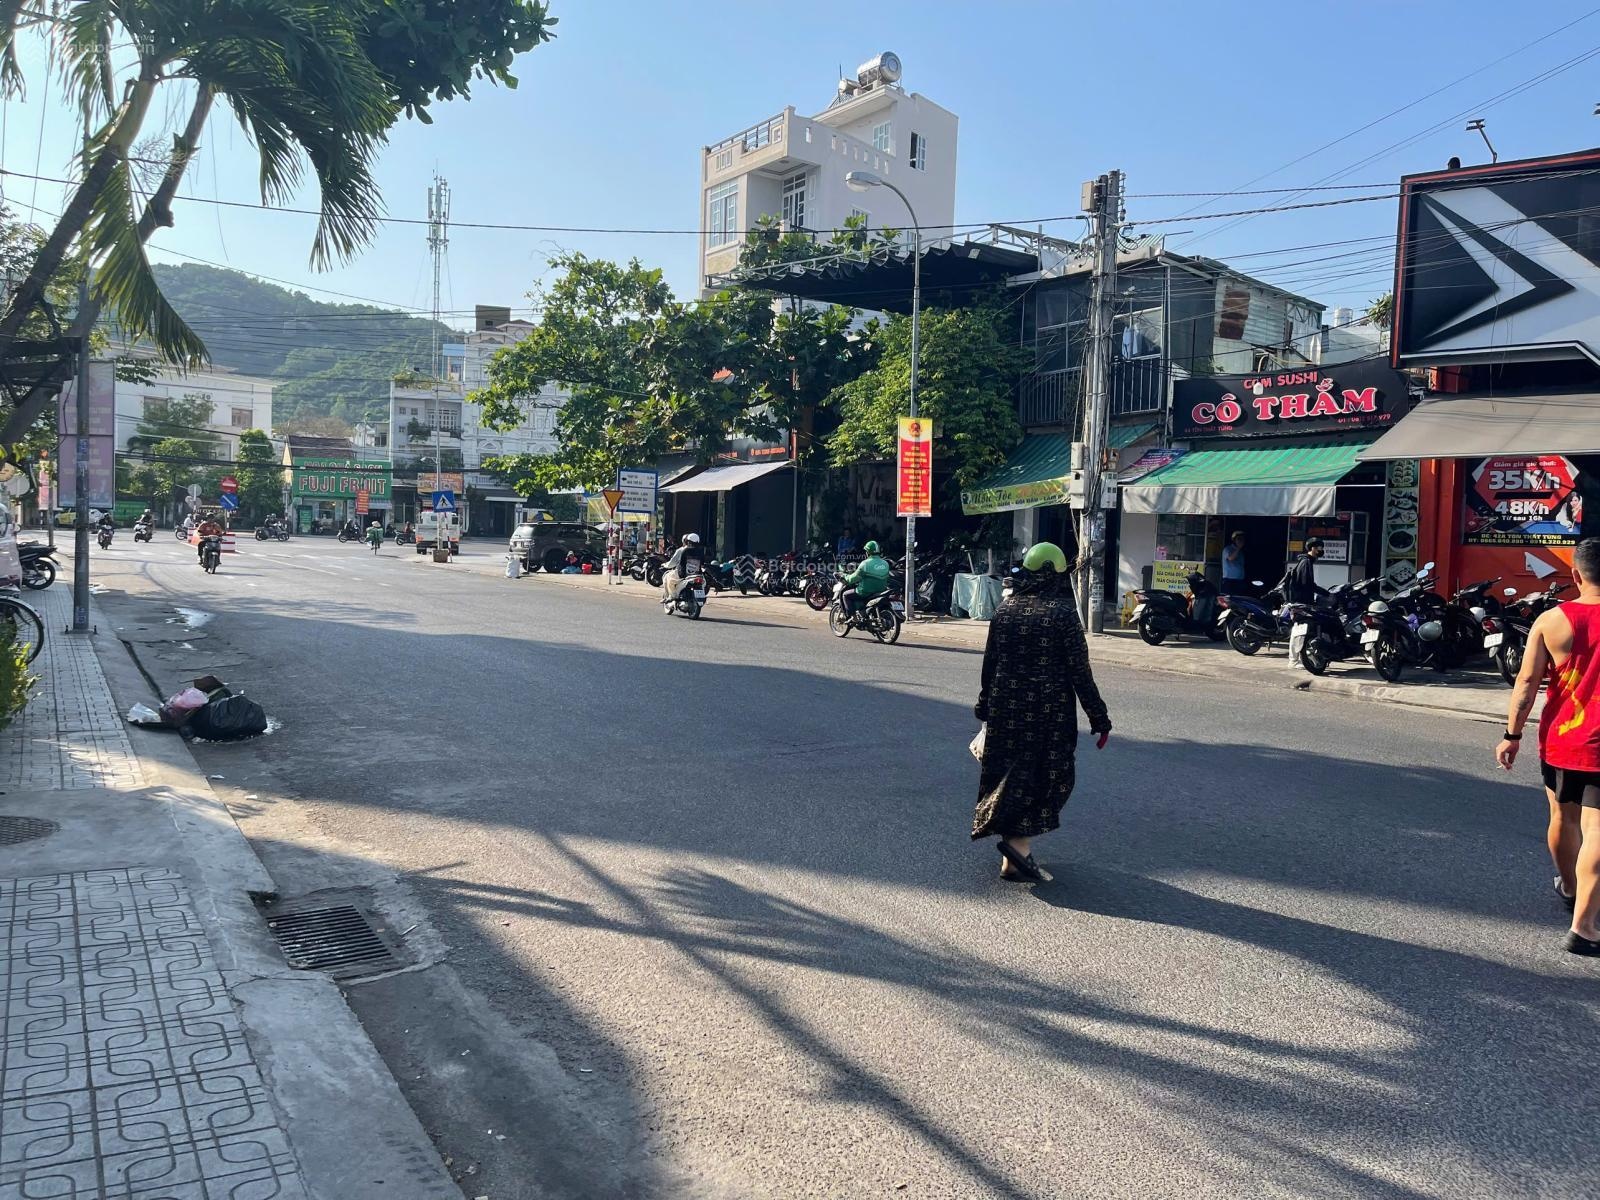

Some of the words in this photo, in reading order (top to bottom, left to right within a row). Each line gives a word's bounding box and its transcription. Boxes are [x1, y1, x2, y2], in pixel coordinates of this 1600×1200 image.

[1277, 371, 1318, 387] SUSHI
[1191, 392, 1242, 425] CÔ
[1252, 377, 1379, 421] THẮM
[299, 475, 336, 492] FUJI
[340, 477, 387, 494] FRUIT
[1488, 469, 1560, 491] 35K/h
[1495, 500, 1550, 515] 48K/h
